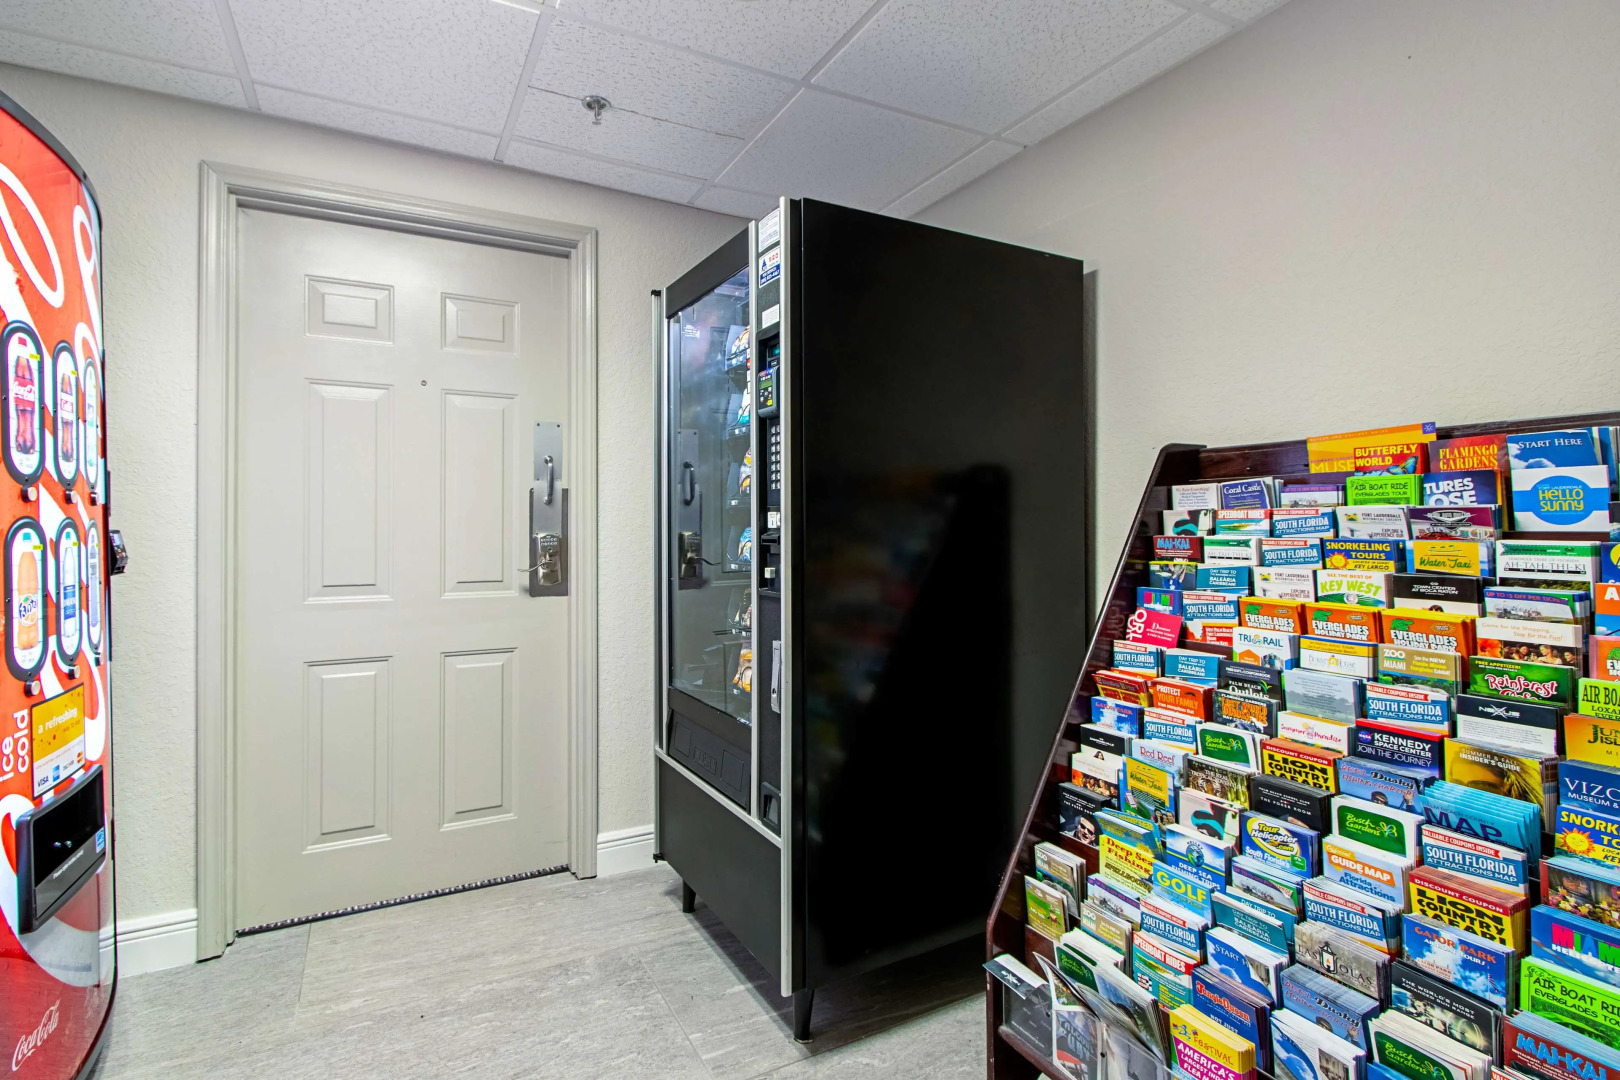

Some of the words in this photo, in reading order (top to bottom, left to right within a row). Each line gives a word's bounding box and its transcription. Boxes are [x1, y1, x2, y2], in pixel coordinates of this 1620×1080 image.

[1355, 444, 1417, 457] BUTTERFLY
[1439, 444, 1498, 459] FLAMINGO
[1519, 440, 1551, 449] START
[1356, 457, 1392, 466] WORLD
[1440, 455, 1498, 470] GARDENS
[1242, 483, 1262, 492] Castle
[1275, 520, 1296, 530] SOUTH
[1298, 517, 1328, 528] FLORIDA
[1265, 550, 1286, 559] SOUTH
[1288, 549, 1318, 557] FLORIDA
[1326, 541, 1390, 551] SNORKELING
[1320, 581, 1344, 593] KEY
[1346, 580, 1382, 596] WEST
[1208, 603, 1234, 613] FLORIDA
[1245, 614, 1294, 627] EVERGLADES
[1312, 620, 1368, 635] EVERGLADES
[1238, 634, 1251, 644] TRI
[1263, 637, 1283, 648] RAIL
[1390, 629, 1457, 648] EVERGLADES
[1115, 653, 1132, 662] SOUTH
[1134, 654, 1154, 662] FLORIDA
[1384, 649, 1405, 658] ZOO
[1384, 660, 1406, 670] MIAMI
[1157, 685, 1180, 696] PROTECT
[1485, 674, 1558, 698] Rainforest
[1158, 694, 1174, 703] YOUR
[1175, 698, 1198, 709] FAMILY
[1369, 700, 1398, 712] SOUTH
[1401, 704, 1442, 716] FLORIDA
[1369, 710, 1422, 719] ATTRACTIONS
[1479, 704, 1520, 719] NEXUS
[38, 725, 43, 734] a
[45, 708, 78, 730] refreshing
[1146, 723, 1166, 733] SOUTH
[1167, 725, 1193, 737] FLORIDA
[13, 709, 29, 773] cold
[1374, 733, 1431, 751] KENNEDY
[1374, 740, 1398, 751] SPACE
[1400, 745, 1432, 758] CENTER
[0, 736, 14, 782] Ice
[1140, 746, 1155, 758] Red
[1158, 752, 1176, 764] Reef
[1266, 745, 1299, 757] DISCOUNT
[1300, 754, 1328, 765] COUPON
[1357, 745, 1376, 755] JOIN
[1377, 749, 1392, 759] THE
[1393, 752, 1432, 768] JOURNEY
[1459, 753, 1496, 765] INSIDER'S
[1498, 761, 1520, 772] GUIDE
[1268, 754, 1328, 776] LION
[1268, 763, 1330, 783] COUNTRY
[38, 776, 49, 787] VISA
[1568, 792, 1610, 806] MUSEUM
[1258, 823, 1280, 833] Tour
[1345, 812, 1375, 827] Busch
[1346, 820, 1381, 836] Gardens
[1424, 806, 1502, 842] MAP
[1251, 829, 1298, 844] Helicopter
[1423, 830, 1449, 842] VALUABLE
[1450, 837, 1475, 850] COUPONS
[1476, 845, 1495, 855] INSIDE
[1107, 838, 1132, 856] Deep
[1135, 853, 1153, 866] Sea
[1108, 847, 1151, 875] Fishing
[1245, 846, 1262, 858] South
[1263, 852, 1290, 868] Florida's
[1427, 846, 1462, 864] SOUTH
[1467, 856, 1516, 876] FLORIDA
[1179, 862, 1197, 874] DEEP
[1199, 871, 1212, 880] SEA
[1331, 855, 1364, 870] GUIDE
[1365, 865, 1391, 881] MAP
[1427, 857, 1492, 876] ATTRACTIONS
[1495, 872, 1517, 882] MAP
[1156, 871, 1207, 902] GOLF
[1344, 872, 1372, 887] Florida
[1339, 876, 1396, 902] Attractions
[1414, 878, 1460, 897] DISCOUNT
[1463, 895, 1503, 912] COUPON
[1253, 904, 1266, 914] TRIP
[1416, 888, 1504, 926] LION
[1307, 902, 1336, 921] SOUTH
[1338, 911, 1379, 931] FLORIDA
[1308, 911, 1362, 932] ATTRACTIONS
[1363, 926, 1380, 937] MAP
[1417, 898, 1505, 936] COUNTRY
[1143, 914, 1165, 932] SOUTH
[1167, 923, 1196, 942] FLORIDA
[1144, 924, 1183, 943] ATTRACTIONS
[1183, 939, 1196, 948] MAP
[1133, 933, 1164, 964] SPEEDBOAT
[1166, 954, 1185, 973] RIDES
[1215, 944, 1240, 962] START
[1414, 927, 1455, 948] GATOR
[1460, 944, 1496, 964] PARK
[1534, 988, 1598, 1018] EVERGLADES
[1177, 1042, 1235, 1080] AMERICA'S
[1385, 1040, 1416, 1064] Busch
[1516, 1033, 1607, 1080] MAI-KAI
[1181, 1054, 1208, 1074] LARGEST
[1385, 1049, 1427, 1074] Gardens
[1183, 1063, 1205, 1080] FLEA
